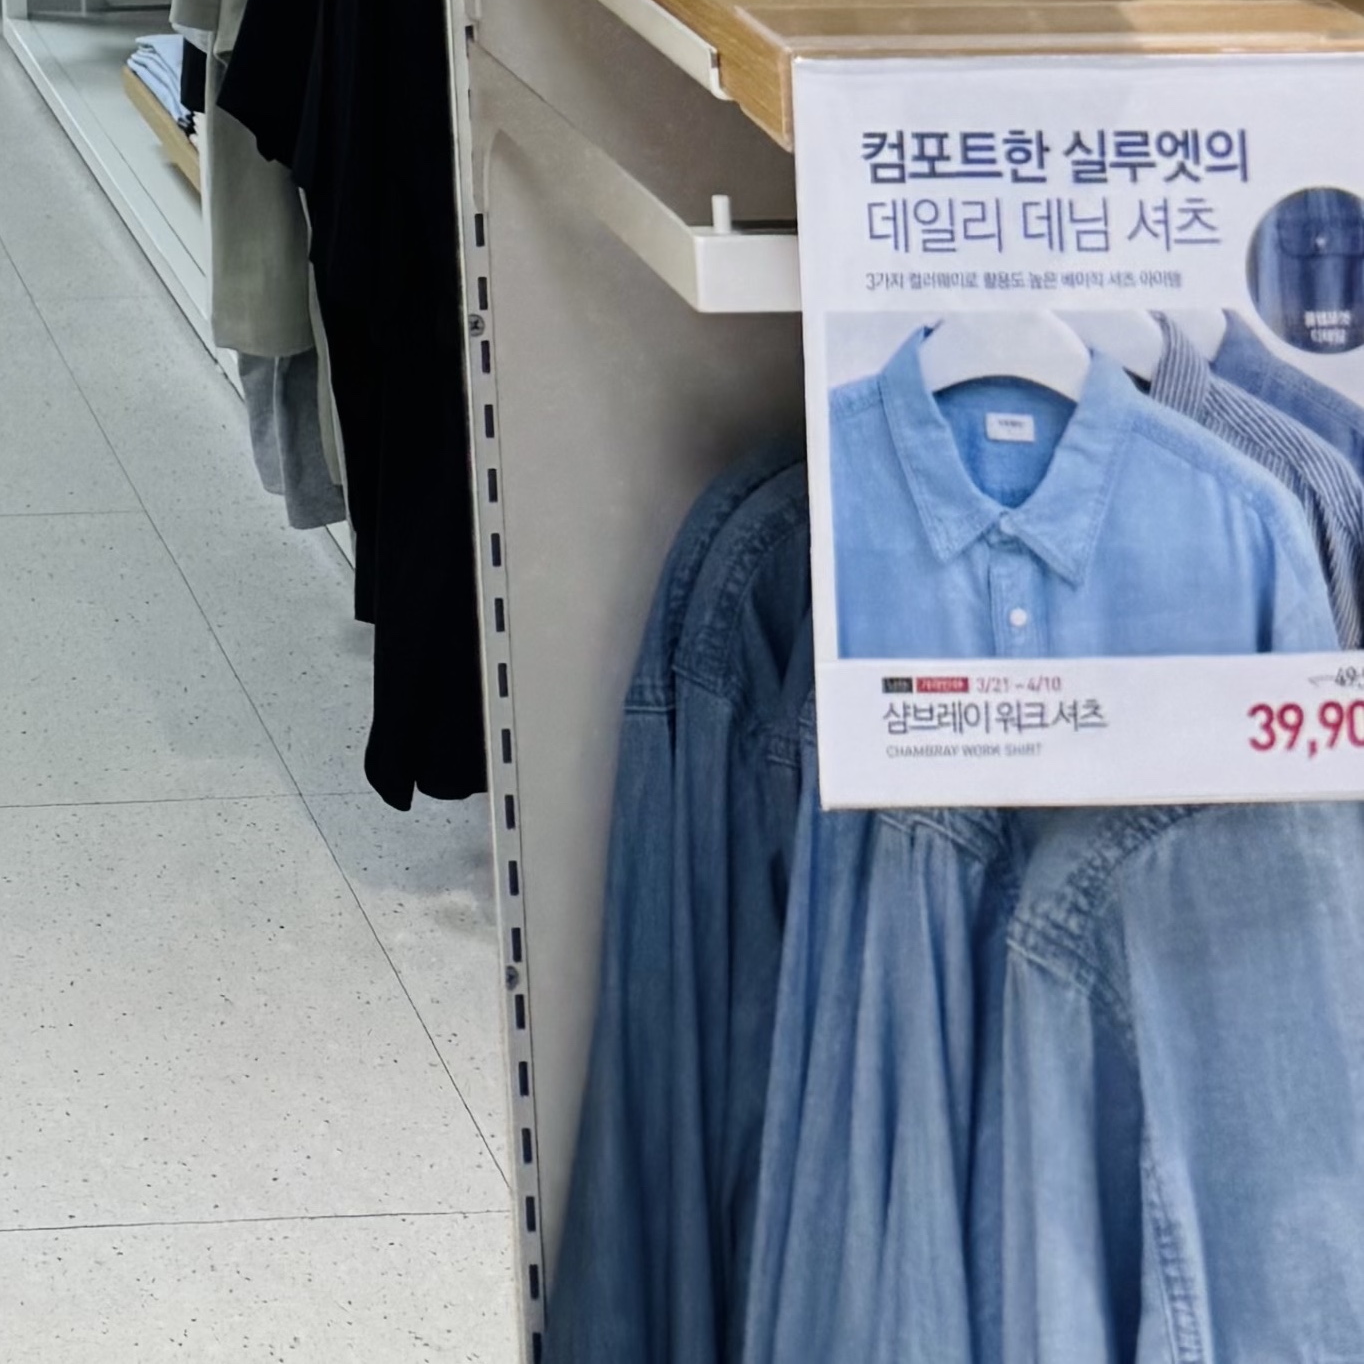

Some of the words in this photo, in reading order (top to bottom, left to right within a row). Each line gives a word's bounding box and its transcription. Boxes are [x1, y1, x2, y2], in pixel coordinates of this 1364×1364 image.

[861, 129, 1051, 184] 컴포트한
[1062, 128, 1250, 184] 실루엣의
[866, 197, 1004, 253] 데일리
[1021, 197, 1111, 253] 데님
[1127, 197, 1222, 253] 셔츠
[976, 677, 1010, 693] 3/21
[1027, 676, 1062, 693] 4/10
[883, 699, 991, 735] 샴브레이
[995, 700, 1050, 734] 워크
[1052, 699, 1108, 732] 셔츠
[886, 744, 958, 758] CHAMBRAY
[962, 744, 1001, 758] WORK
[1005, 743, 1042, 757] SHIRT
